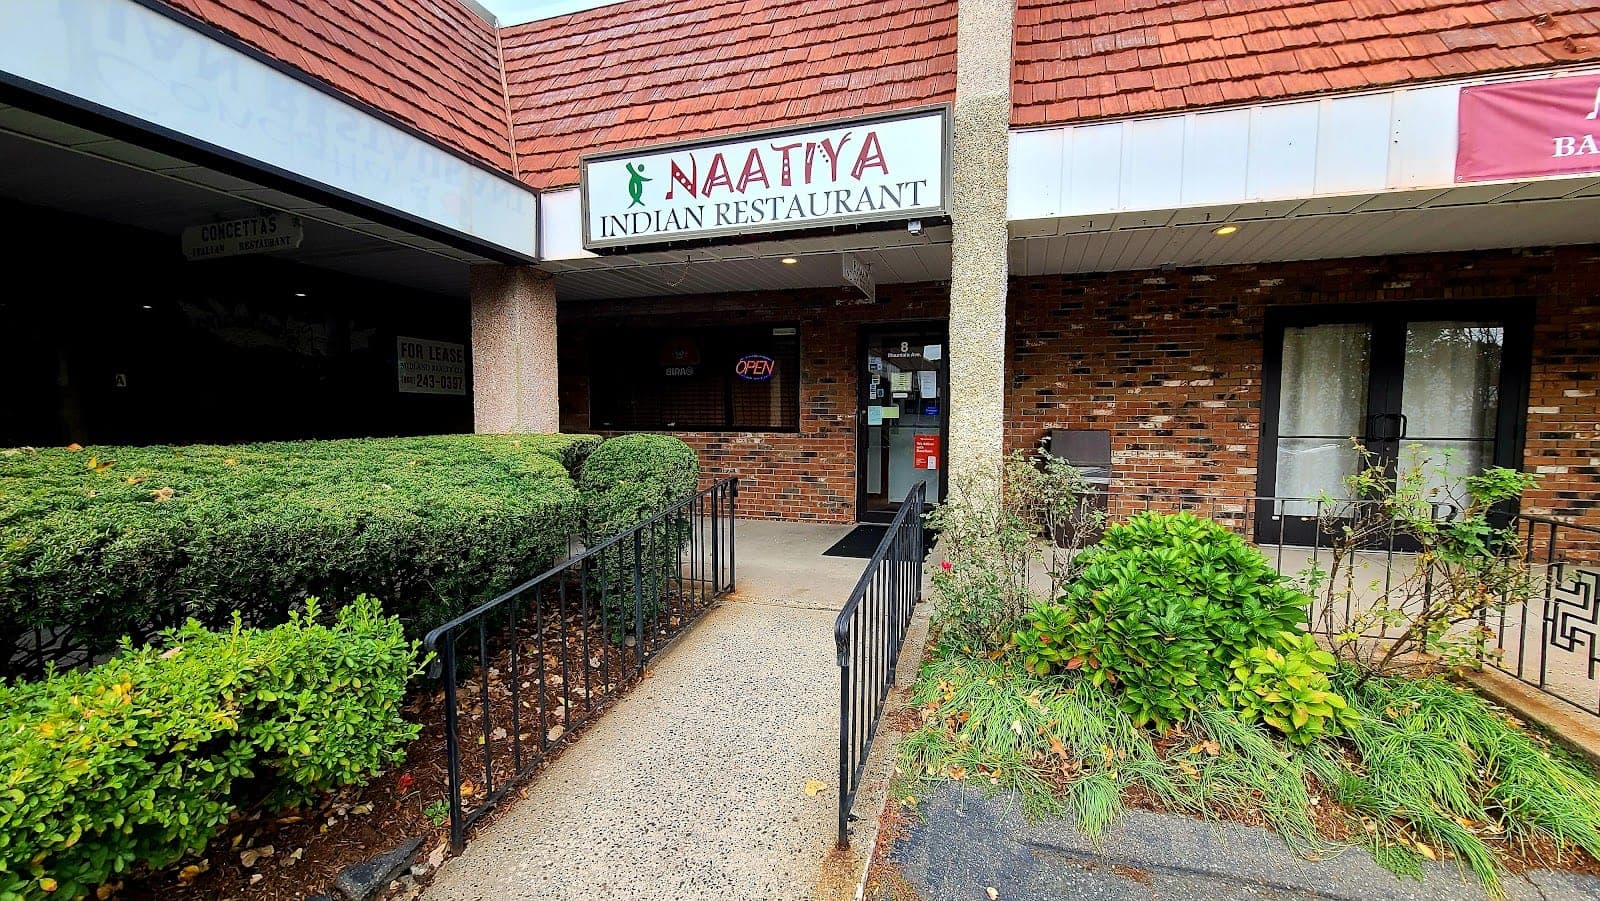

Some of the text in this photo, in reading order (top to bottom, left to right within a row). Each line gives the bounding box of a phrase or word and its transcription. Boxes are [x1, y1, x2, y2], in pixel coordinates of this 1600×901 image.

[665, 131, 889, 200] NAATIYA
[601, 180, 927, 239] INDIAN RESTAURANT
[239, 236, 291, 251] RESTAURANT
[401, 342, 463, 363] FOR LEASE
[900, 341, 909, 353] 8
[735, 359, 775, 376] OPEN
[417, 374, 463, 390] 243-0397
